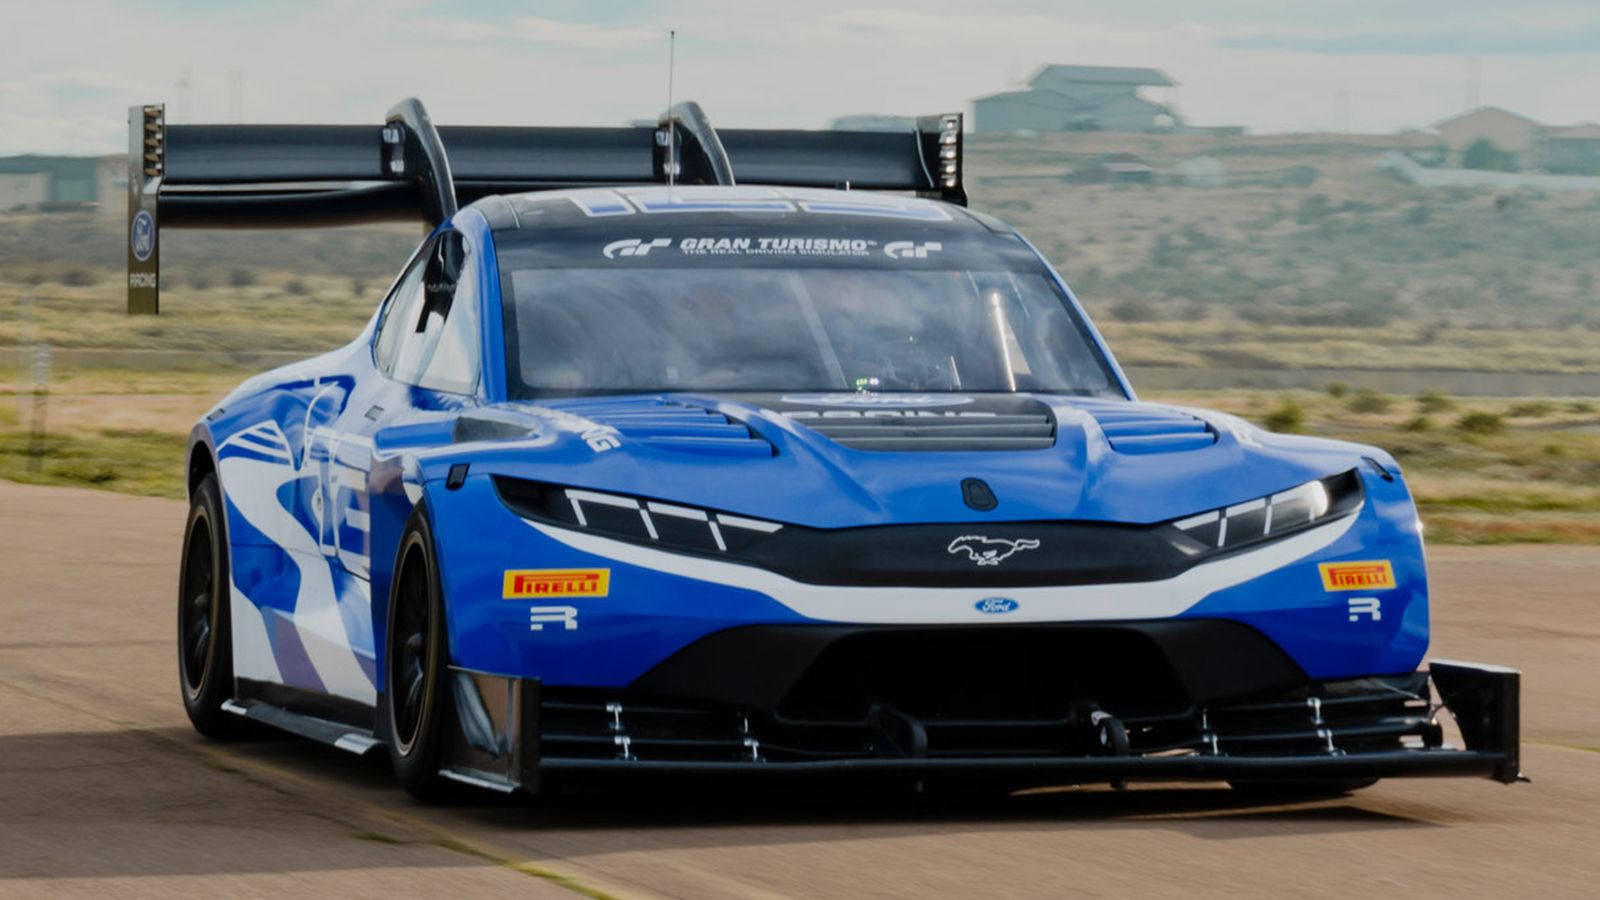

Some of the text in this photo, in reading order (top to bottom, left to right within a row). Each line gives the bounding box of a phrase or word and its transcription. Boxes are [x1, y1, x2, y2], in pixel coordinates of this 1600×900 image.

[680, 238, 751, 250] GRAN
[514, 574, 599, 593] PIRELLI
[1328, 566, 1387, 587] PIRELLI
